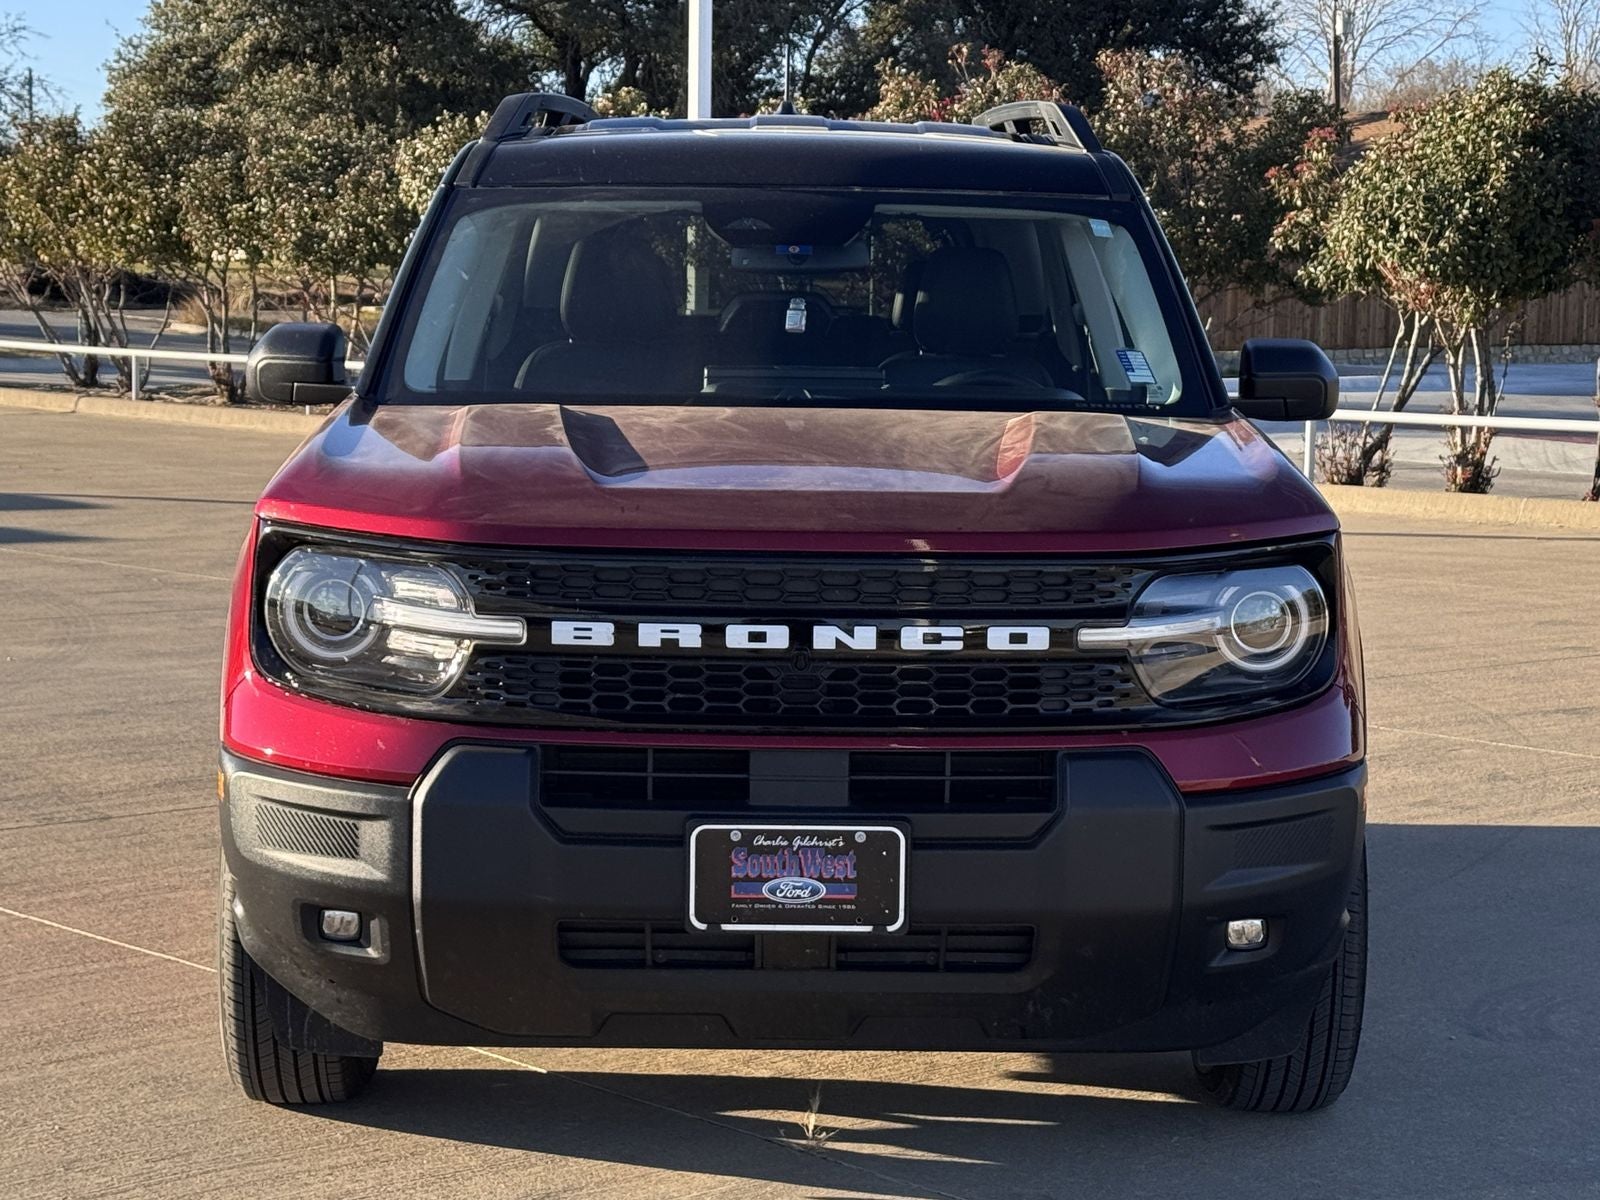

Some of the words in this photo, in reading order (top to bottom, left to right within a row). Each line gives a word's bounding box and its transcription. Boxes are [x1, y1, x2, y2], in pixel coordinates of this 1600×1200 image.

[551, 620, 1050, 651] BRONCO
[753, 835, 789, 846] Charlie
[731, 846, 857, 880] SouthWest
[776, 881, 813, 898] Ford
